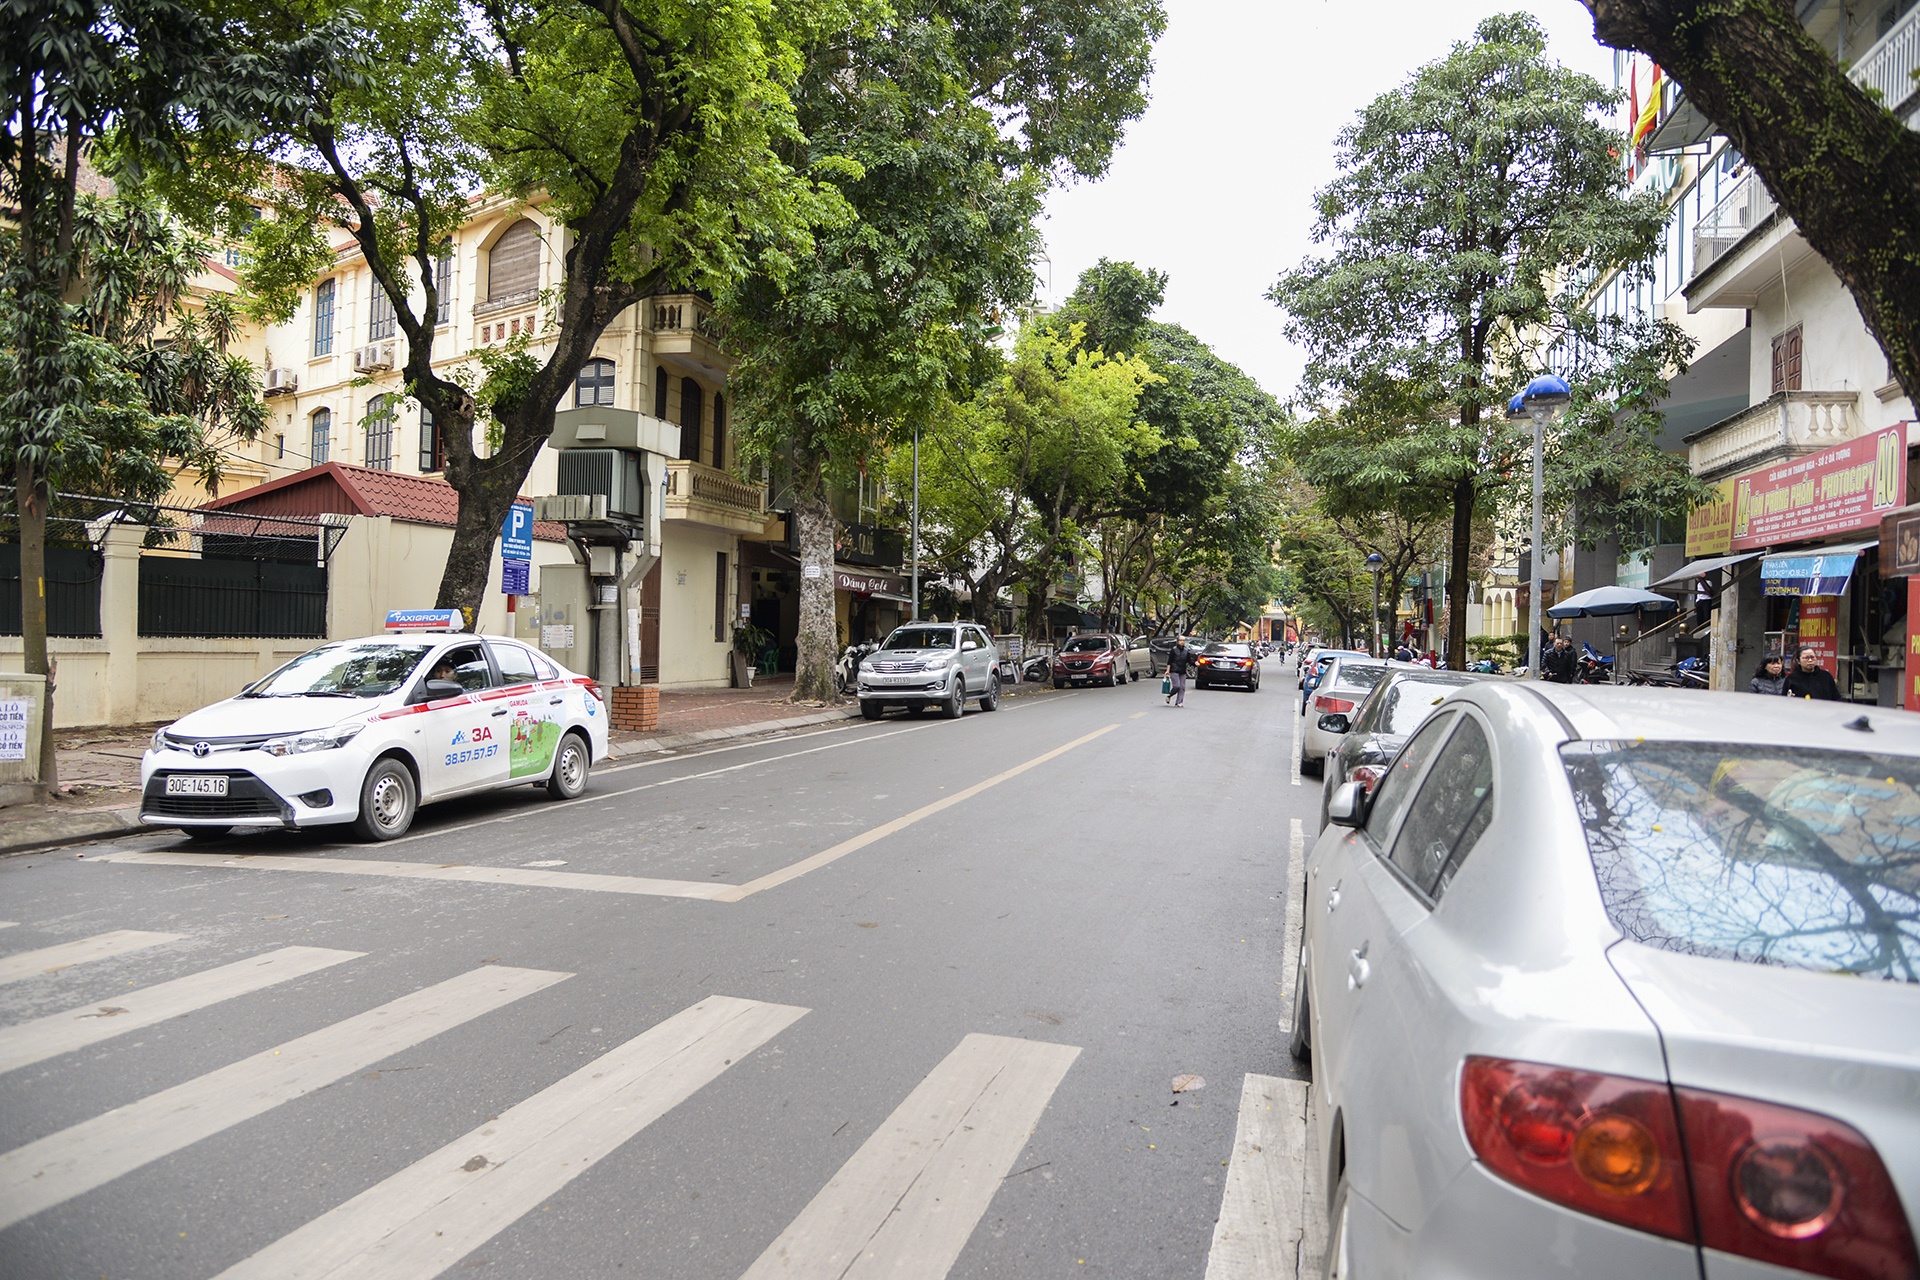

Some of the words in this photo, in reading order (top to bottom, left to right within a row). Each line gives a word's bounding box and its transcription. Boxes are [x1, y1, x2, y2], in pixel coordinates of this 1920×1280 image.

[1788, 468, 1792, 476] IN
[1792, 463, 1805, 474] THANH
[1806, 460, 1815, 470] NGA
[1818, 453, 1824, 466] SỐ
[1824, 456, 1828, 464] 2
[1750, 490, 1764, 519] VĂN
[1764, 484, 1789, 516] PHÒNG
[1790, 472, 1814, 510] PHẨM
[1820, 460, 1876, 502] PHOTOCOPY
[1844, 494, 1867, 505] CATALOGUE
[1845, 505, 1861, 514] PLASTIC
[512, 510, 524, 538] P
[839, 574, 866, 592] Dáng
[472, 727, 492, 742] 3A
[445, 744, 498, 766] 38.57.57.57
[169, 779, 225, 793] 30E-145.16
